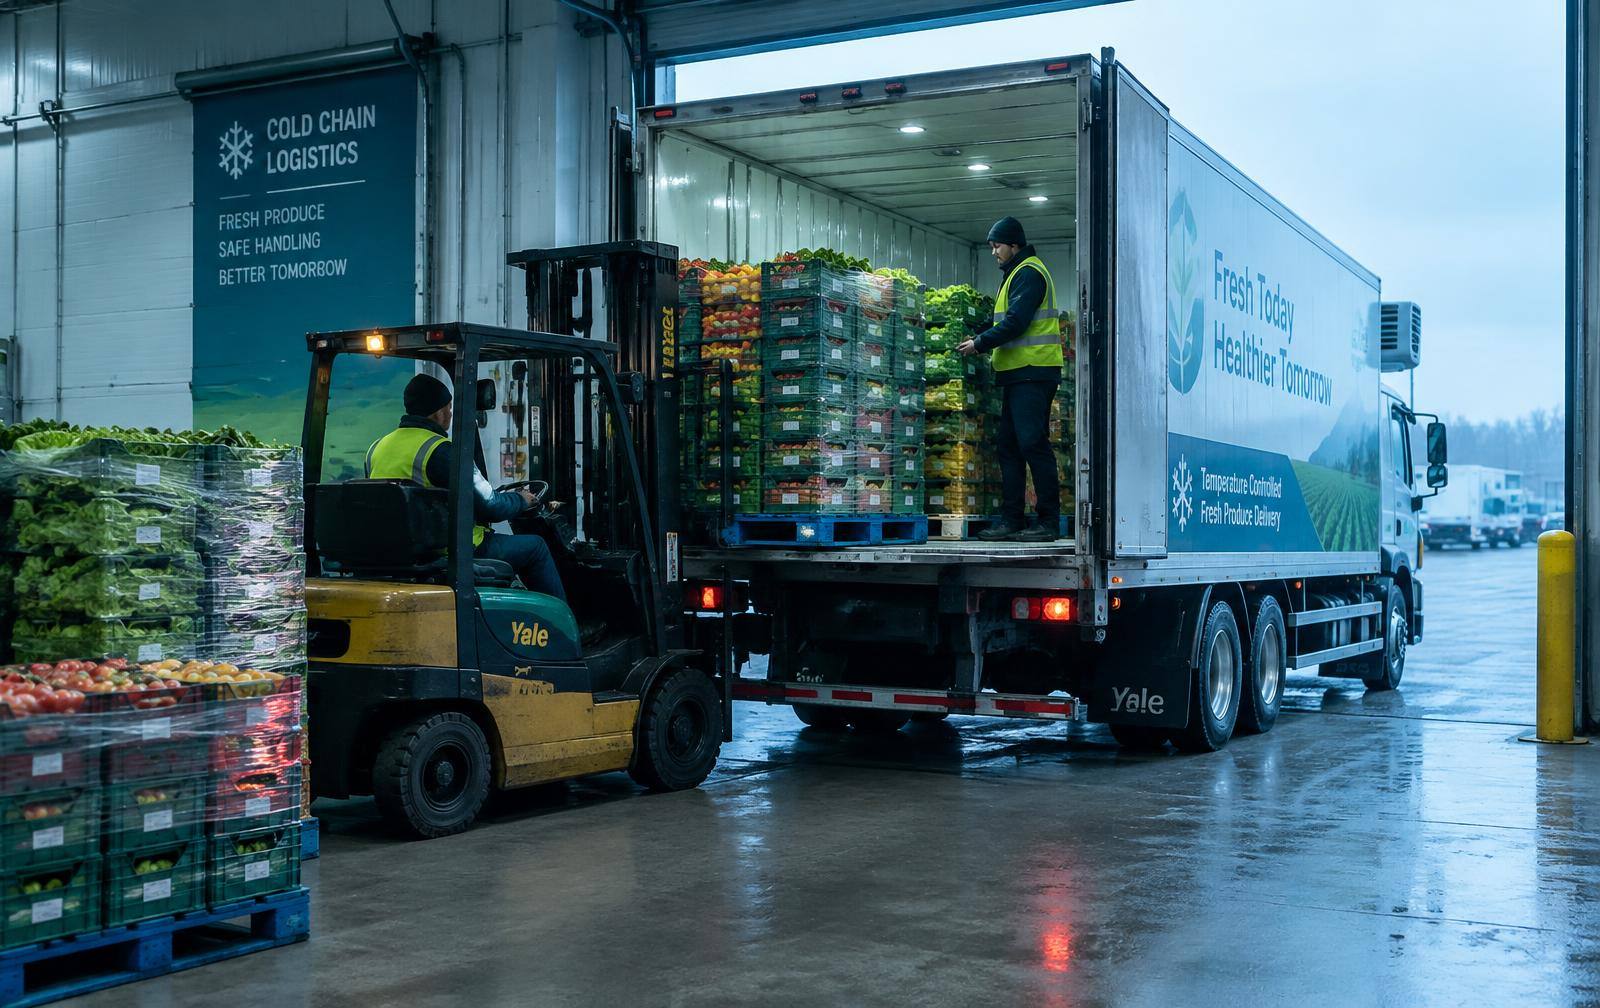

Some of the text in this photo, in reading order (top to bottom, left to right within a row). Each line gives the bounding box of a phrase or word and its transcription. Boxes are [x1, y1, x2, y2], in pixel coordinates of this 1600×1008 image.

[267, 105, 376, 141] COLD CHAIN
[267, 141, 359, 174] LOGISTICS
[219, 203, 325, 231] FRESH PRODUCE
[219, 232, 321, 258] SAFE HANDLING
[219, 265, 266, 286] BETTER
[1214, 249, 1295, 344] Fresh Today
[1214, 319, 1333, 406] Healthier Tomorrow
[1201, 467, 1282, 498] Temperature Controlled
[1201, 500, 1222, 525] Fresh
[1224, 502, 1253, 526] Produce
[512, 621, 549, 647] Yale
[1110, 687, 1164, 715] Yale
